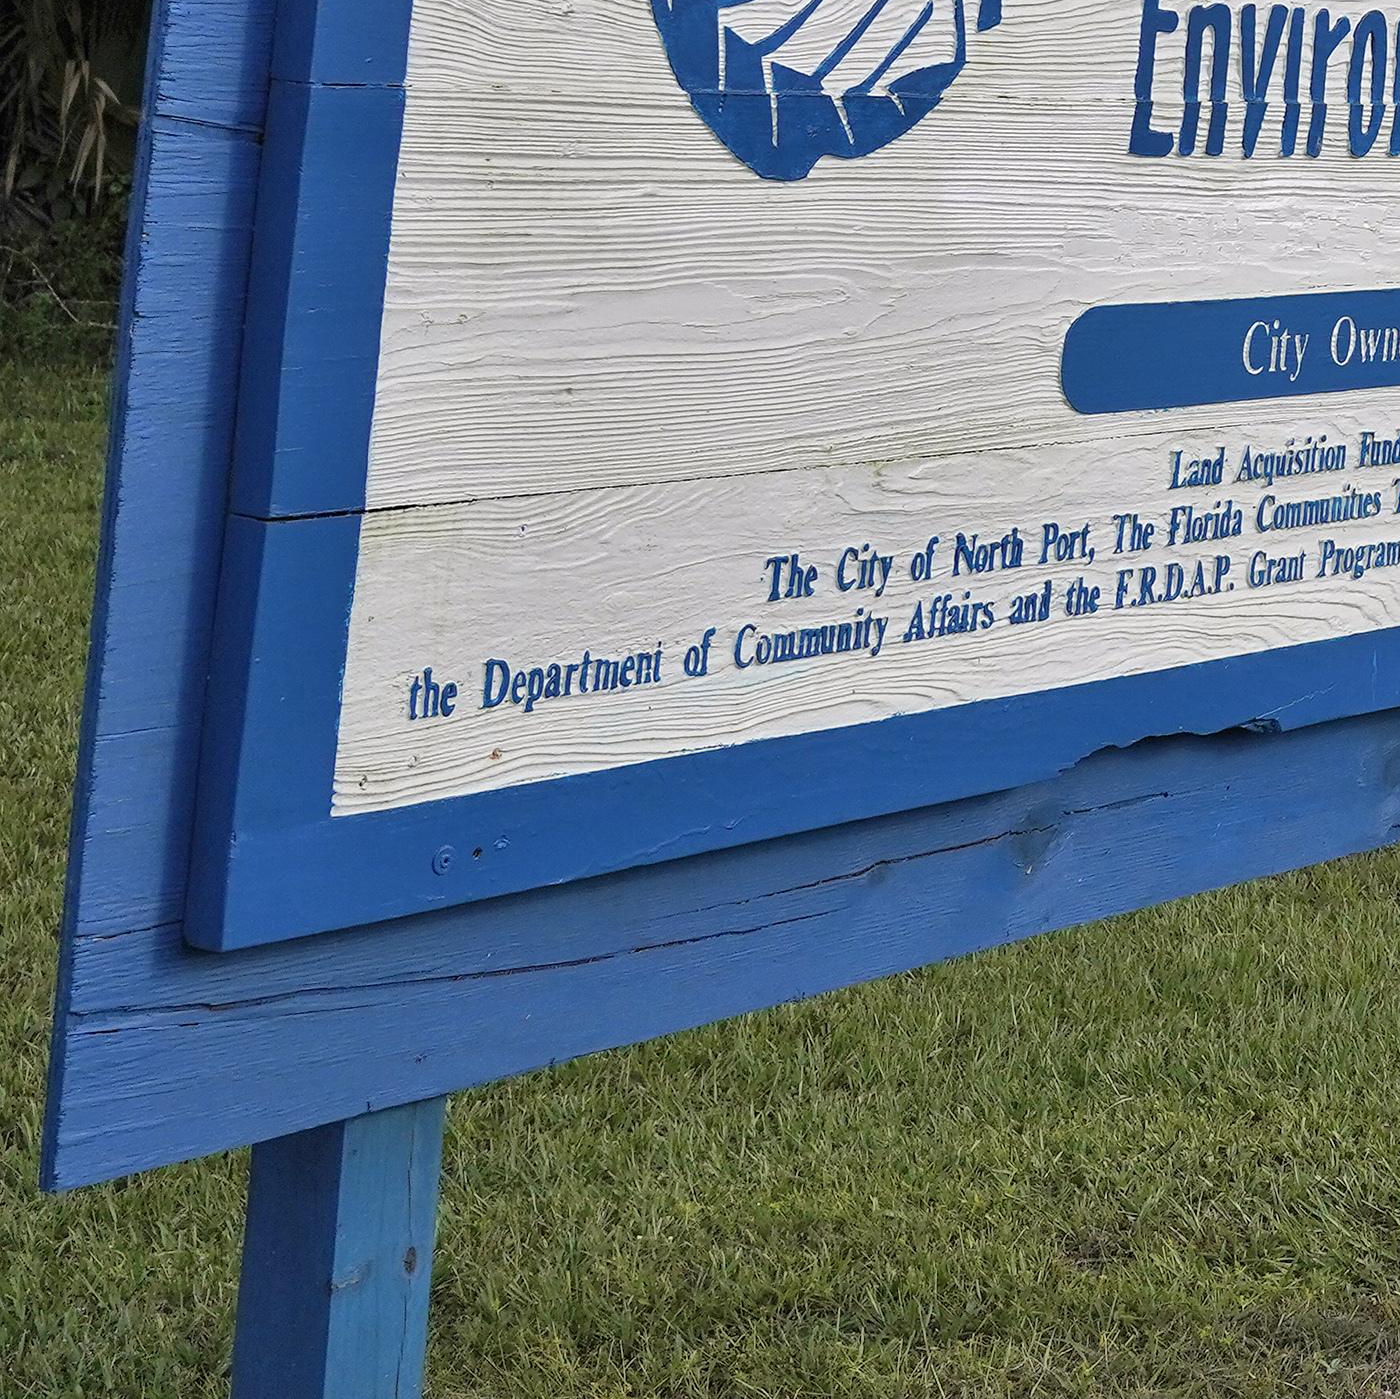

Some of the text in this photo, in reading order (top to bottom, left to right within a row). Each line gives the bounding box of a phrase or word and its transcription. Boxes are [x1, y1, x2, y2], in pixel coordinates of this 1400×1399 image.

[1242, 319, 1309, 381] City
[1168, 446, 1226, 490] Land
[1236, 435, 1346, 487] Acquisition
[765, 553, 818, 601] The
[837, 543, 894, 597] City
[911, 536, 940, 581] of
[952, 527, 1024, 577] North
[1038, 522, 1096, 566] Port,
[1112, 513, 1155, 554] The
[1167, 500, 1243, 547] Florida
[1256, 484, 1382, 532] Communities
[408, 666, 458, 720] the
[478, 641, 663, 713] Department
[683, 627, 716, 677] of
[734, 607, 889, 669] Community
[902, 591, 995, 643] Affairs
[1010, 579, 1052, 624] and
[1065, 577, 1101, 616] the
[1114, 555, 1235, 610] F.R.D.A.P.
[1250, 550, 1307, 588] Grant
